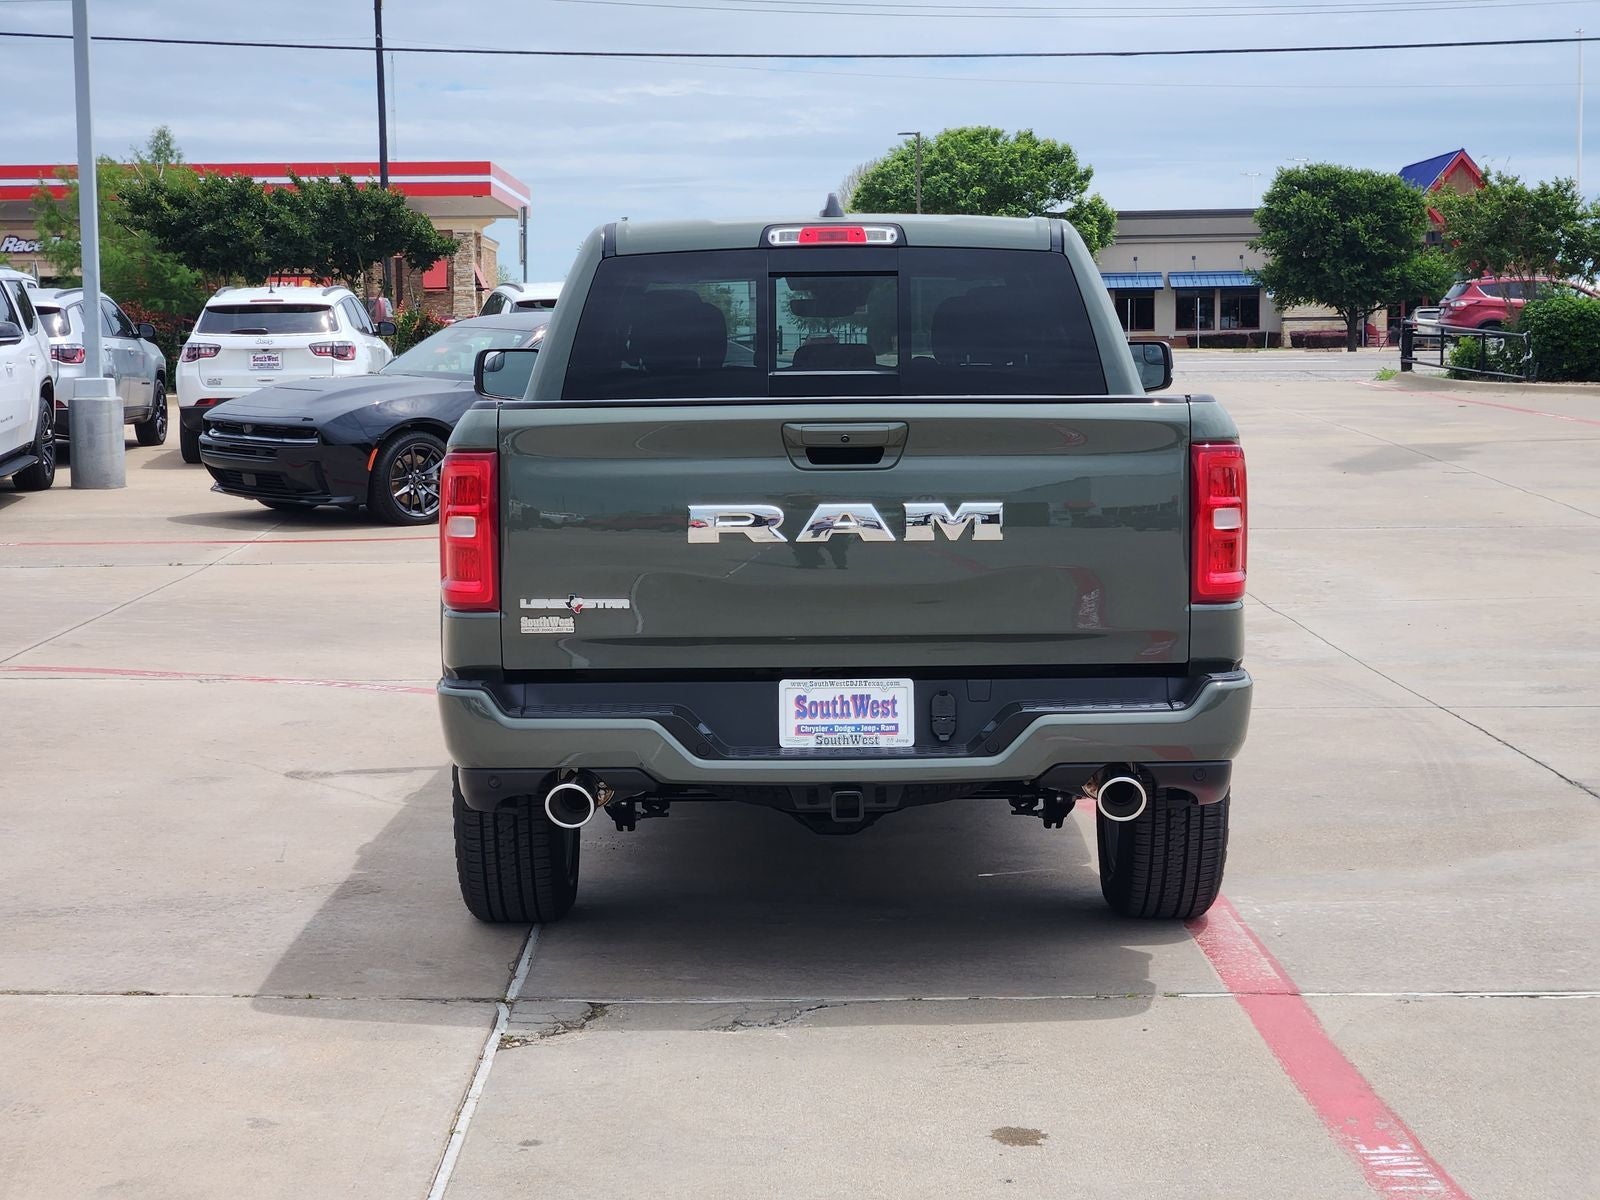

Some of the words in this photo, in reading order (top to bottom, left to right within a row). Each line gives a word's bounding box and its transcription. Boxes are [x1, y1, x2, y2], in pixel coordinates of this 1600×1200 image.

[687, 502, 1004, 543] RAM
[794, 694, 899, 720] SouthWest
[800, 725, 828, 734] Chrysler
[834, 725, 856, 733] Dodge
[860, 725, 877, 733] Jeep
[880, 724, 896, 732] Ram
[815, 734, 880, 746] SouthWest
